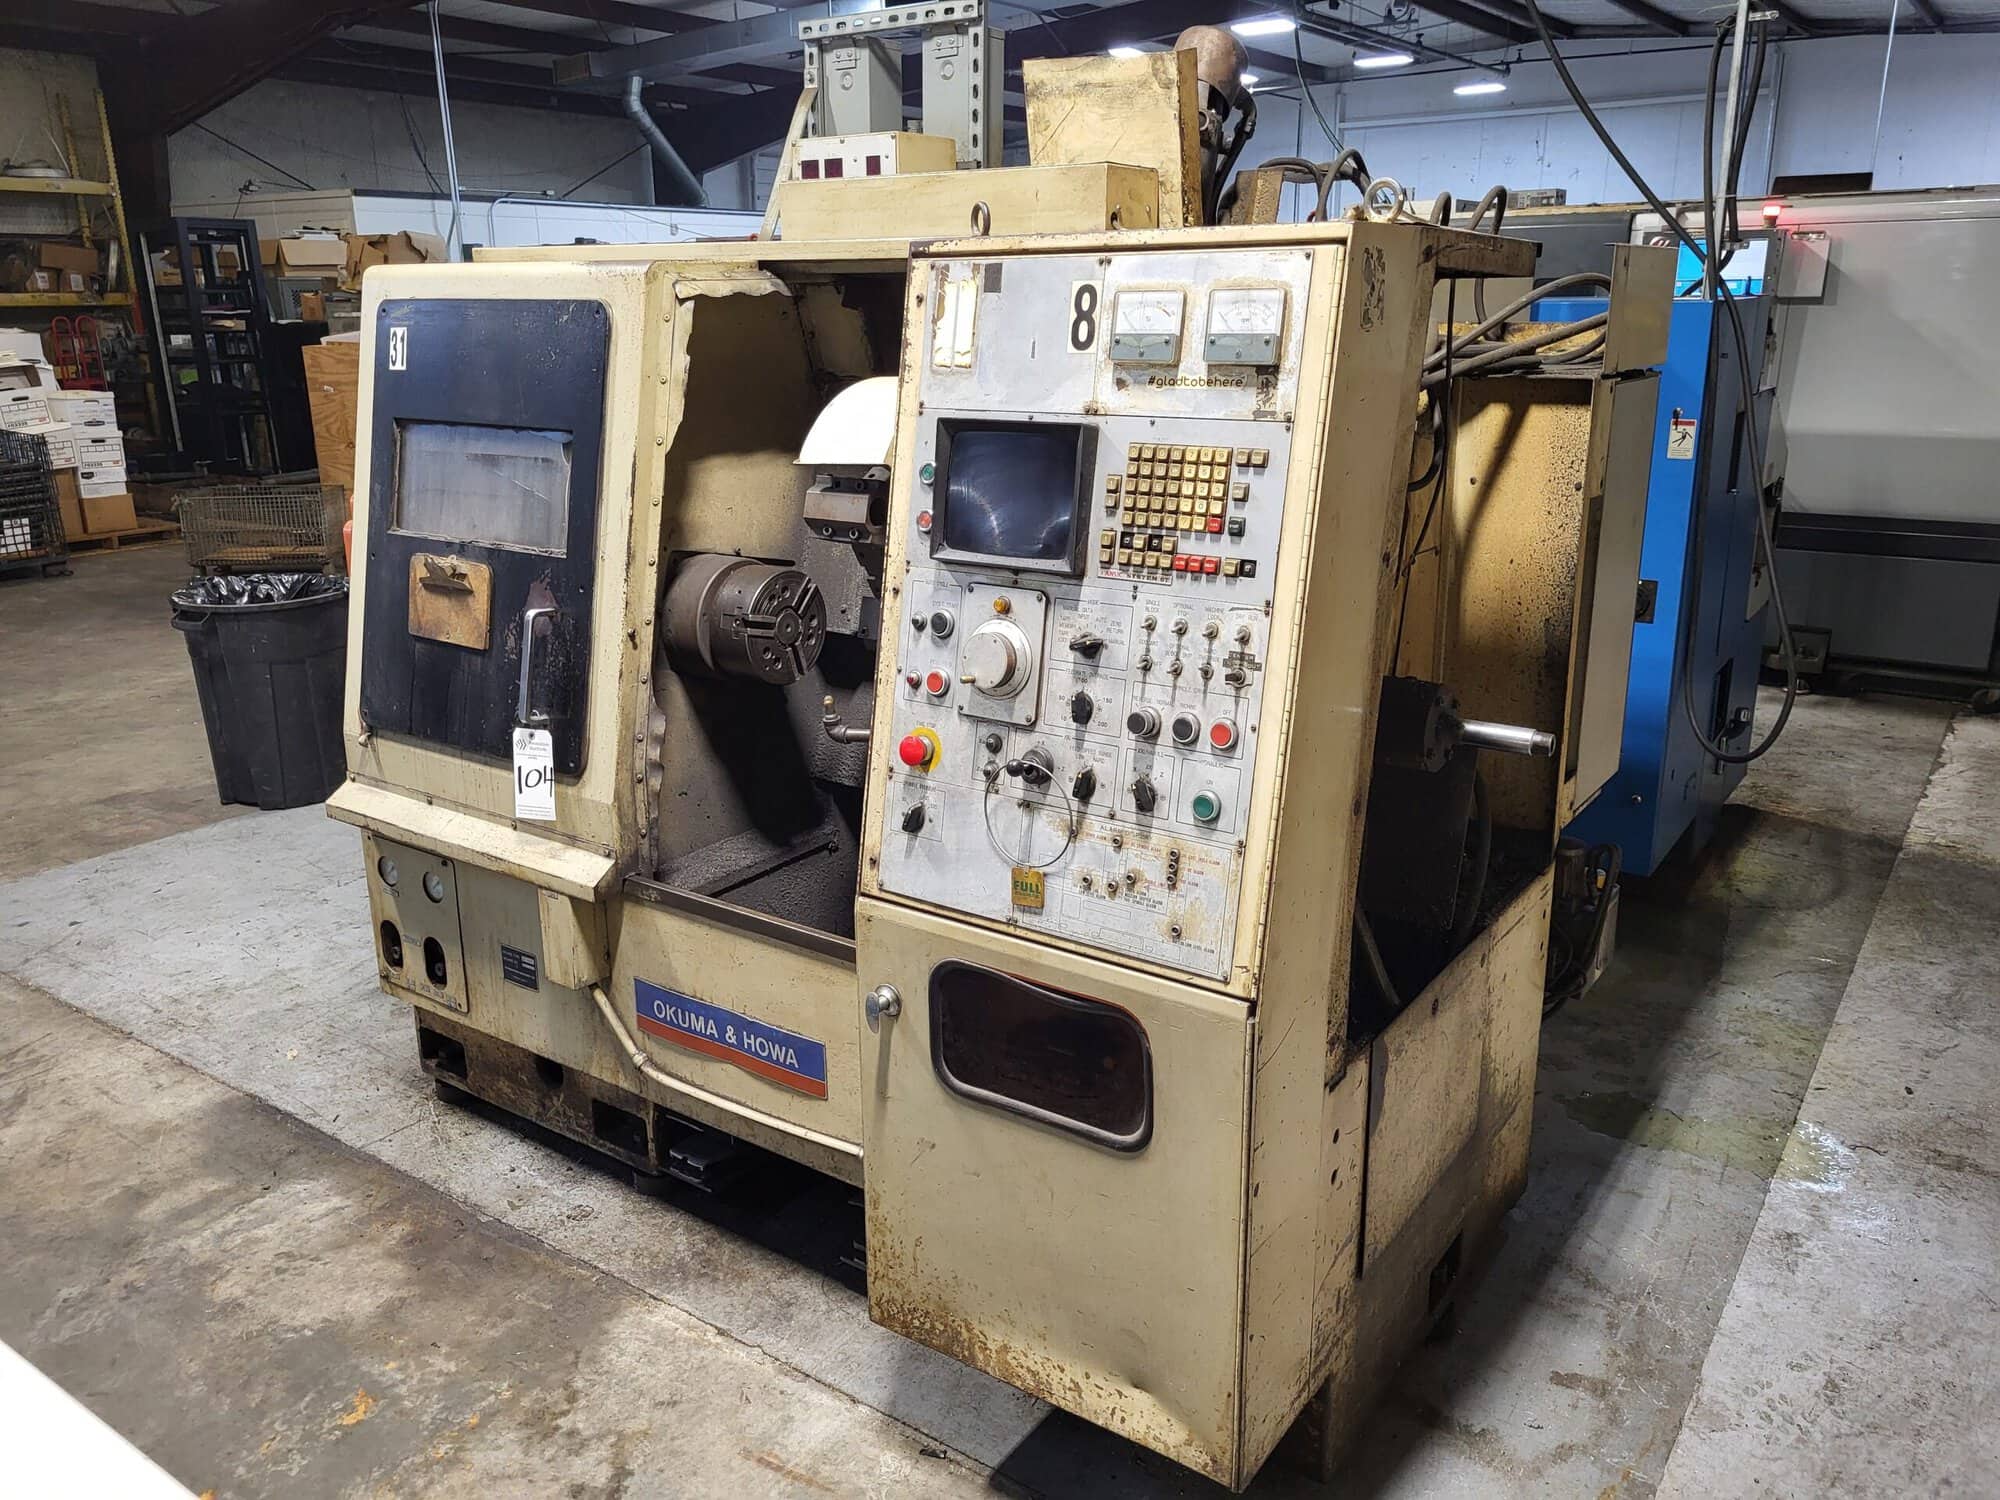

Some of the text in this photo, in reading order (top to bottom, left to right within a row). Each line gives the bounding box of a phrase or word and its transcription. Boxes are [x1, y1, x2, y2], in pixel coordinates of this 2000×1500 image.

[1071, 284, 1097, 351] 8
[391, 329, 405, 367] 31
[1147, 376, 1243, 388] #gladtobehere
[517, 765, 554, 797] 104
[1014, 880, 1041, 895] FULL
[653, 1000, 800, 1068] OKUMA & HOWA
